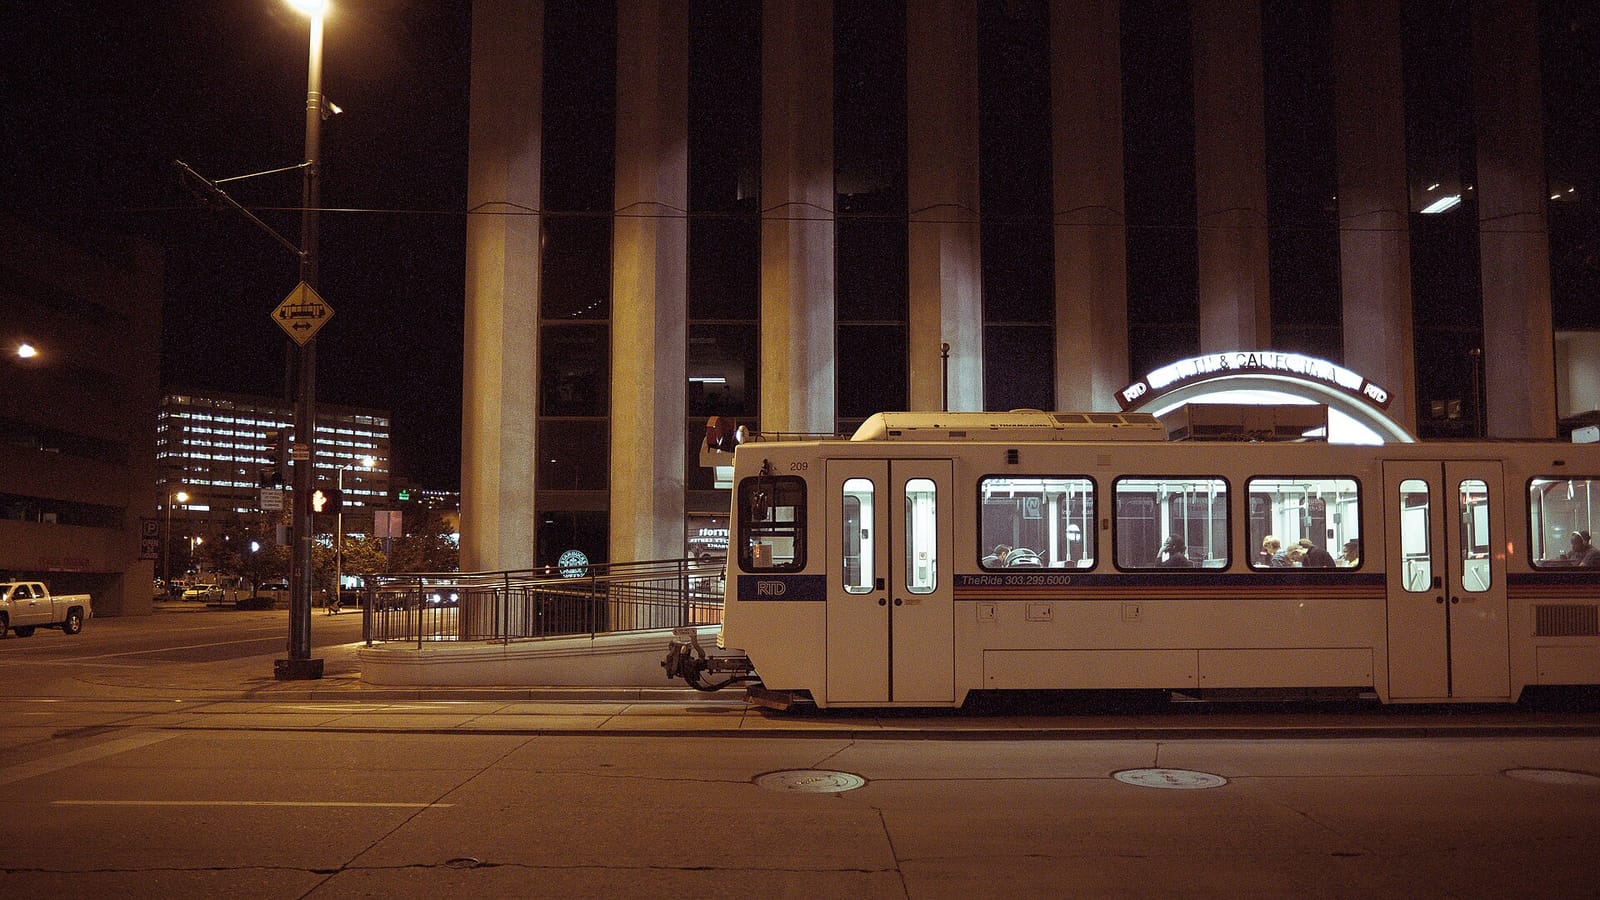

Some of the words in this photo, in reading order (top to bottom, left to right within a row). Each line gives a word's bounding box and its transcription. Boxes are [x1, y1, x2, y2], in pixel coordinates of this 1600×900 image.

[1219, 354, 1229, 369] &
[1122, 382, 1147, 402] RTD
[790, 462, 809, 472] 209
[757, 580, 786, 596] RTD
[962, 575, 1003, 586] TheRide
[1004, 575, 1071, 586] 303.299.6000
